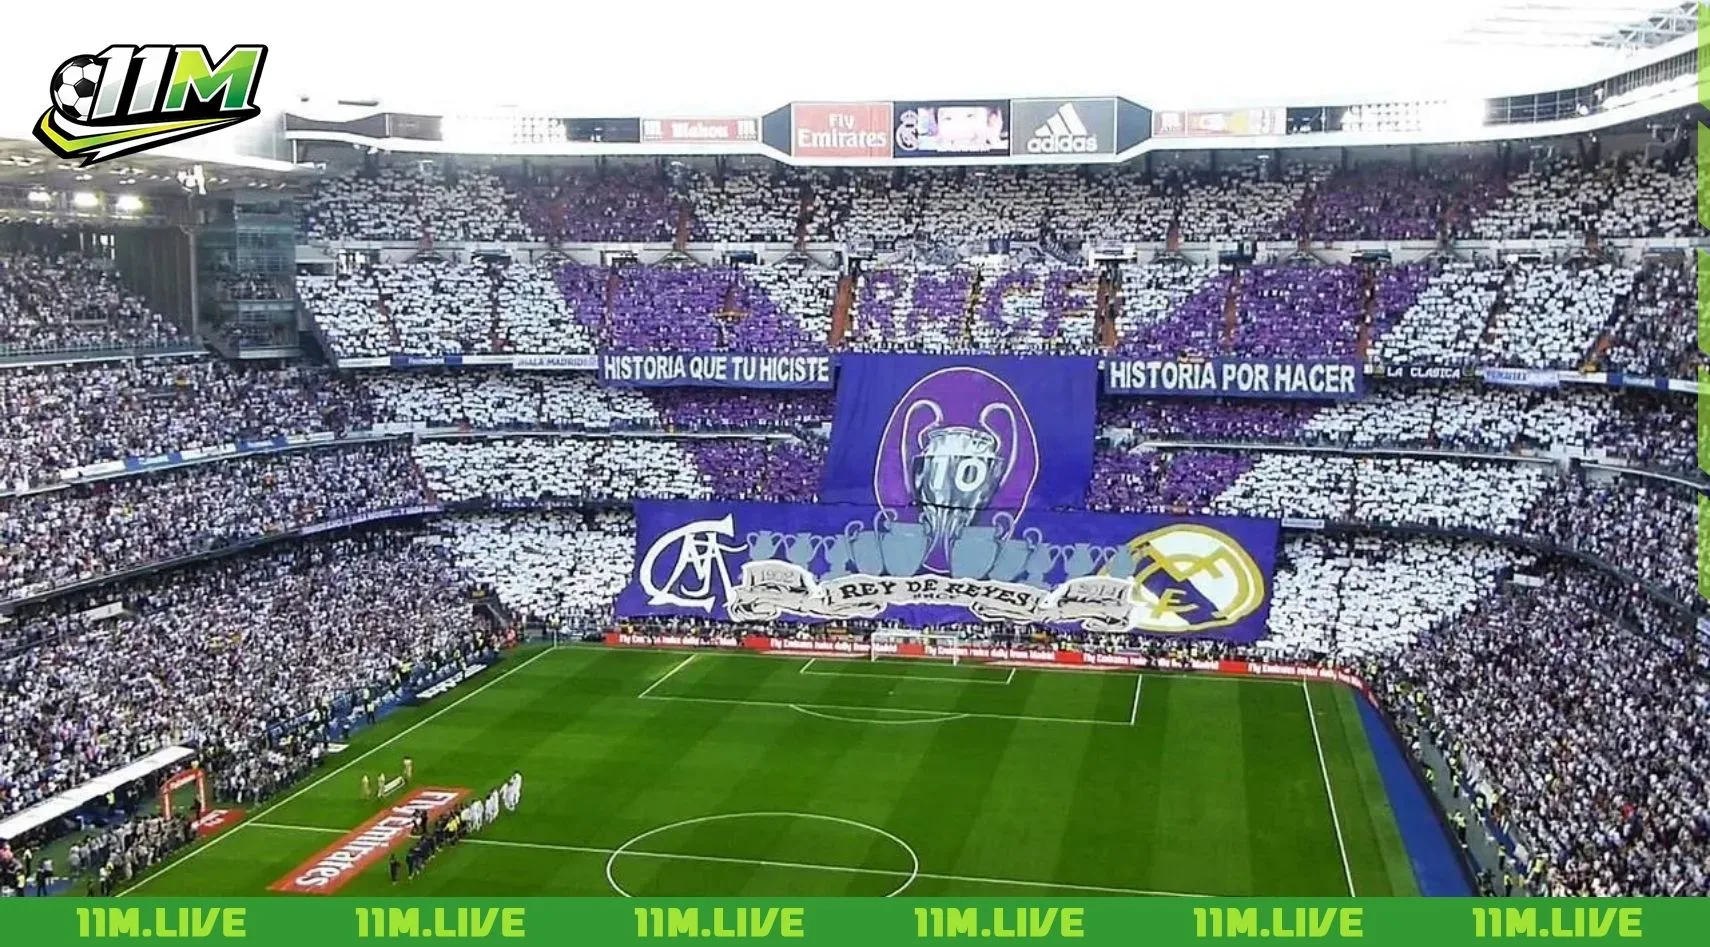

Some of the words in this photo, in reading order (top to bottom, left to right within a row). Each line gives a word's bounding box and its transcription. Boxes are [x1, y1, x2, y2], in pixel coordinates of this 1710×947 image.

[829, 112, 855, 130] Fly
[799, 128, 887, 148] Emirates
[1027, 134, 1098, 153] adidas
[604, 355, 685, 381] HISTORIA
[690, 355, 727, 381] QUE
[732, 356, 755, 381] TU
[760, 356, 830, 382] HICISTE
[1110, 360, 1216, 390] HISTORIA
[1222, 363, 1270, 392] POR
[1274, 364, 1355, 393] HACER
[1387, 366, 1403, 377] LA
[1410, 367, 1461, 379] CLASICA
[932, 456, 987, 492] 10
[840, 581, 897, 599] REY
[907, 578, 939, 593] DE
[945, 582, 1031, 607] REYES
[770, 637, 782, 649] Fly
[783, 638, 813, 649] Emirates
[1083, 653, 1095, 664] Fly
[1096, 654, 1128, 664] Emirates
[1248, 662, 1261, 674] Fly
[1262, 664, 1296, 675] Emirates
[392, 791, 459, 815] Fly
[296, 815, 416, 887] Emirates
